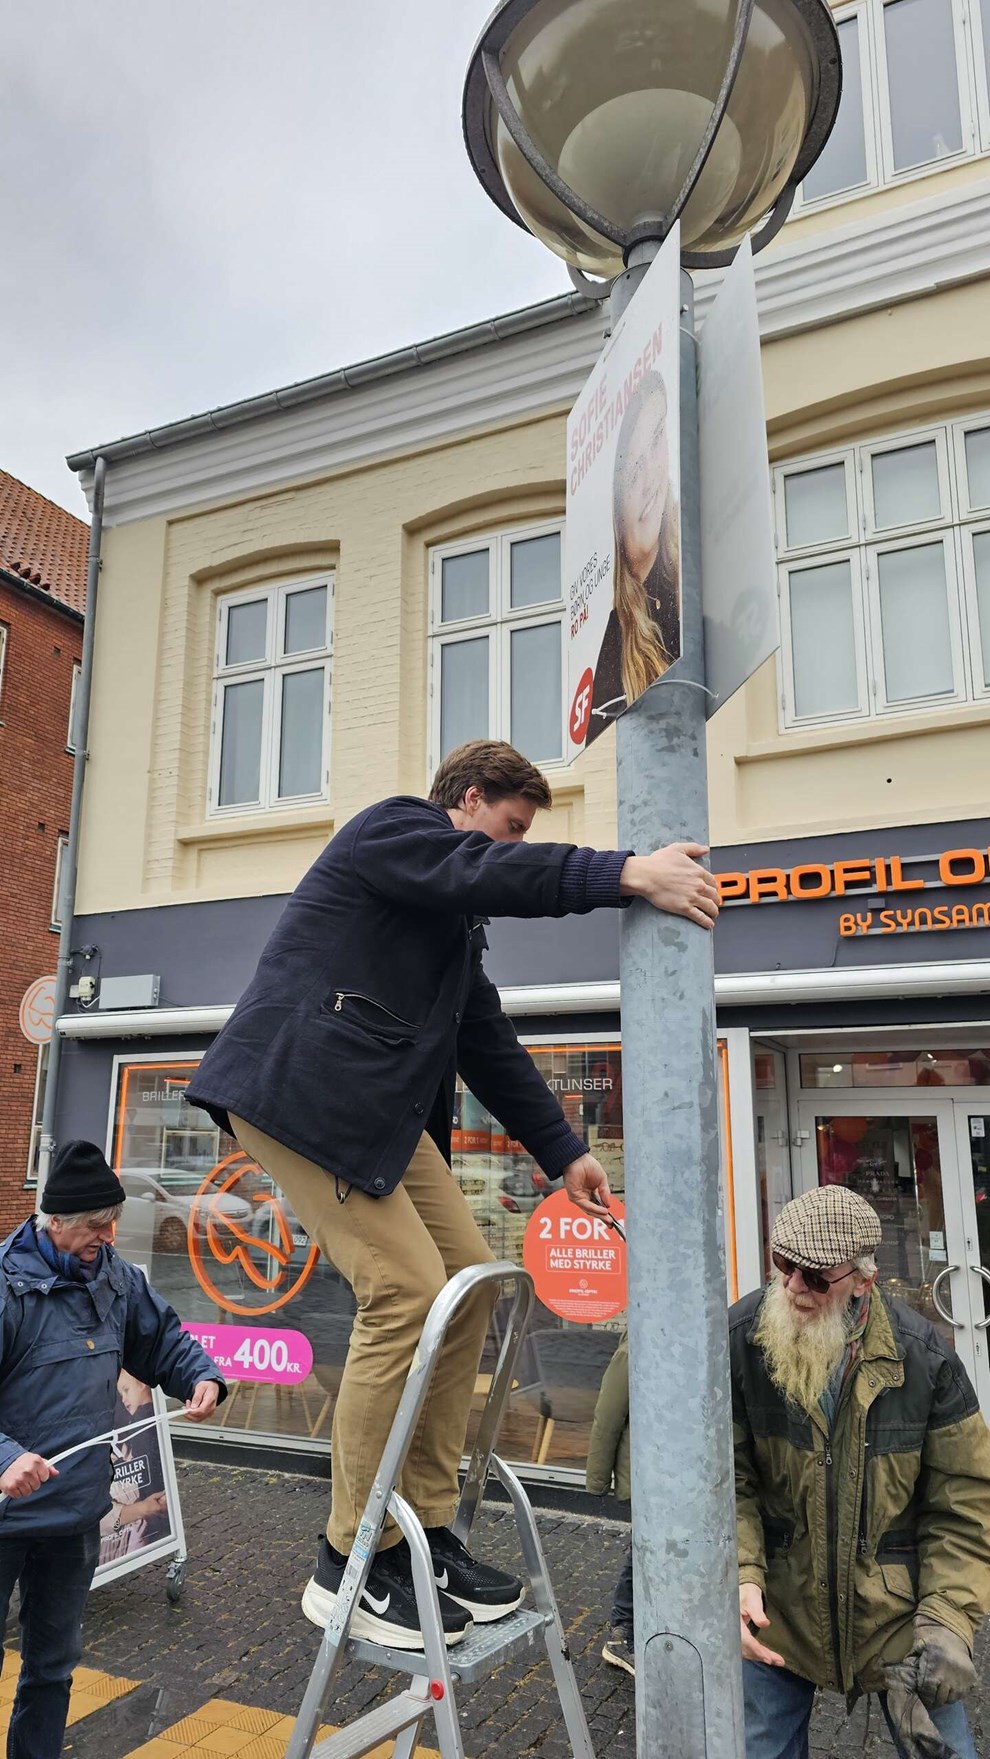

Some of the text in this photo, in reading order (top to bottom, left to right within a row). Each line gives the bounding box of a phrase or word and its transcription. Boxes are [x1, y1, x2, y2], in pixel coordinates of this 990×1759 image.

[570, 322, 663, 496] CHRISTIANSEN
[571, 374, 607, 462] SOFIE
[570, 552, 597, 600] GIV VORES
[585, 578, 593, 600] OG
[594, 554, 610, 588] UNGE
[570, 619, 578, 640] RO
[573, 684, 590, 732] SF
[714, 846, 990, 906] PROFIL O
[839, 902, 990, 937] BY SYNSAM
[142, 1090, 186, 1101] BRILLER
[539, 1217, 552, 1239] 2
[560, 1217, 611, 1240] FOR
[549, 1248, 616, 1259] ALLE BRILLER
[550, 1259, 612, 1270] MED STYRKE
[214, 1356, 232, 1367] FRA
[233, 1338, 288, 1372] 400
[113, 1460, 145, 1480] RILLER
